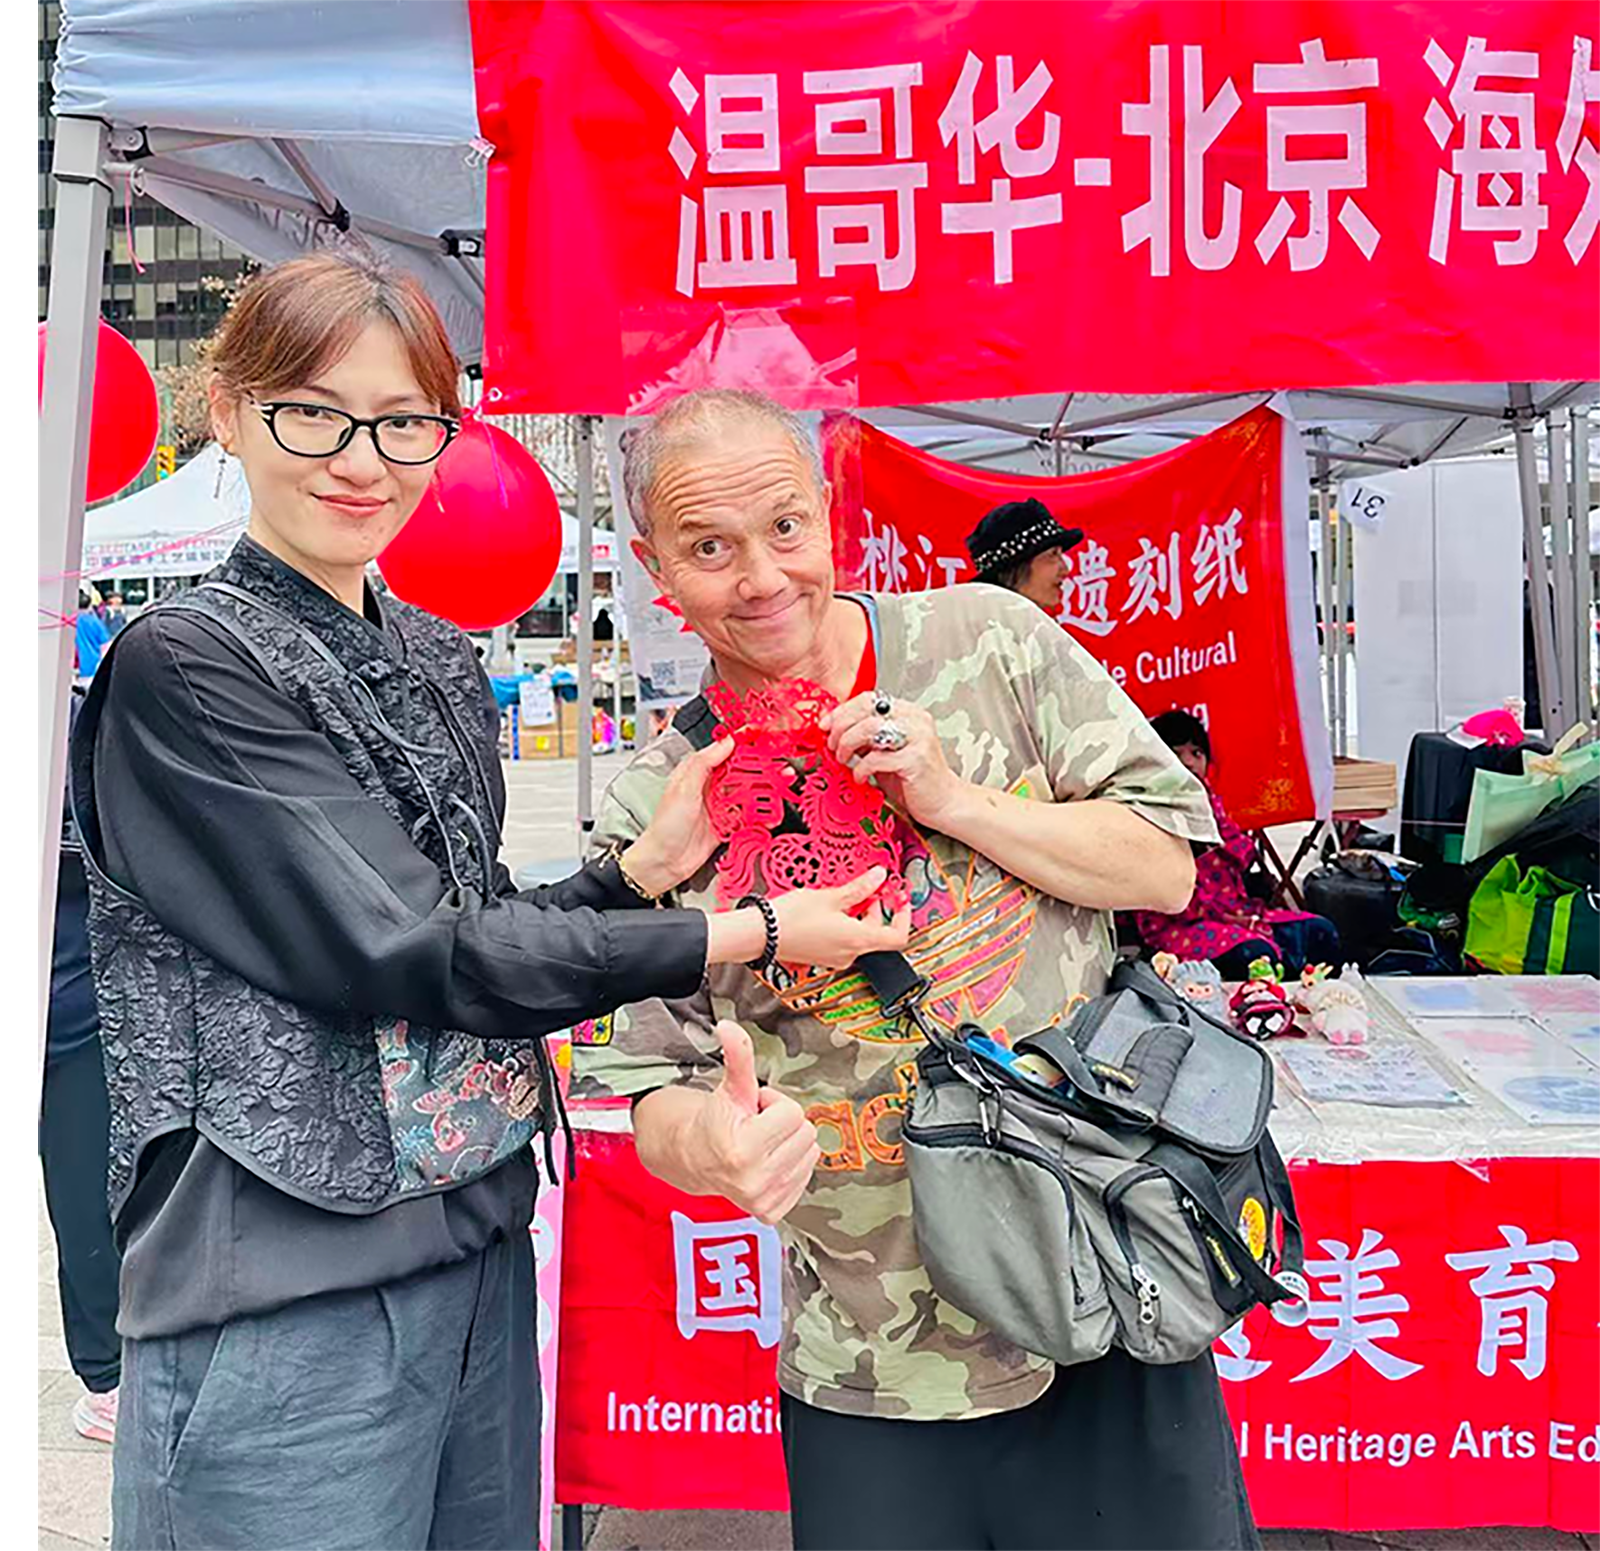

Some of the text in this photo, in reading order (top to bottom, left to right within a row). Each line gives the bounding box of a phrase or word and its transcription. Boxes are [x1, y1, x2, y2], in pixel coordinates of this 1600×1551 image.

[667, 38, 1381, 298] 温哥华-北京
[1351, 487, 1385, 518] 31
[1136, 630, 1237, 683] Cultural
[607, 1391, 782, 1434] Internati
[1265, 1423, 1437, 1468] Heritage
[1449, 1420, 1536, 1459] Arts
